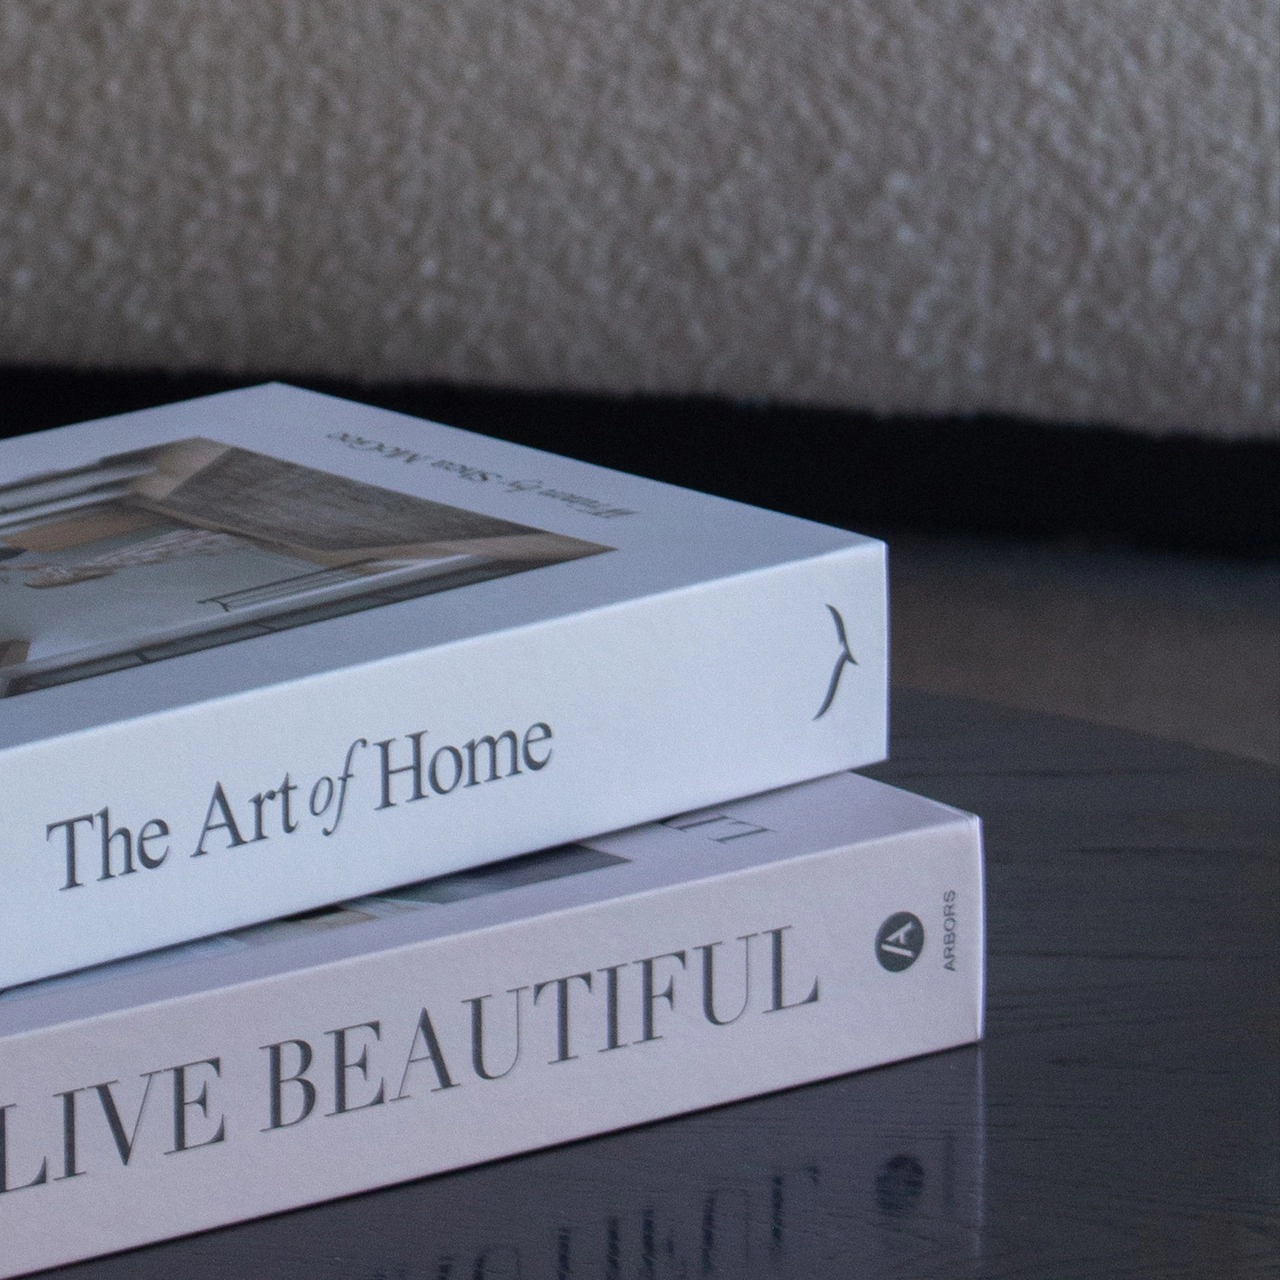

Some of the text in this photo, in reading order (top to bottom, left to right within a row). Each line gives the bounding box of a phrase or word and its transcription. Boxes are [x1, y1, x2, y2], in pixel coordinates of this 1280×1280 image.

[46, 721, 554, 892] The Art of Home
[943, 889, 957, 972] ARBORS
[258, 925, 820, 1133] BEAUTIFUL
